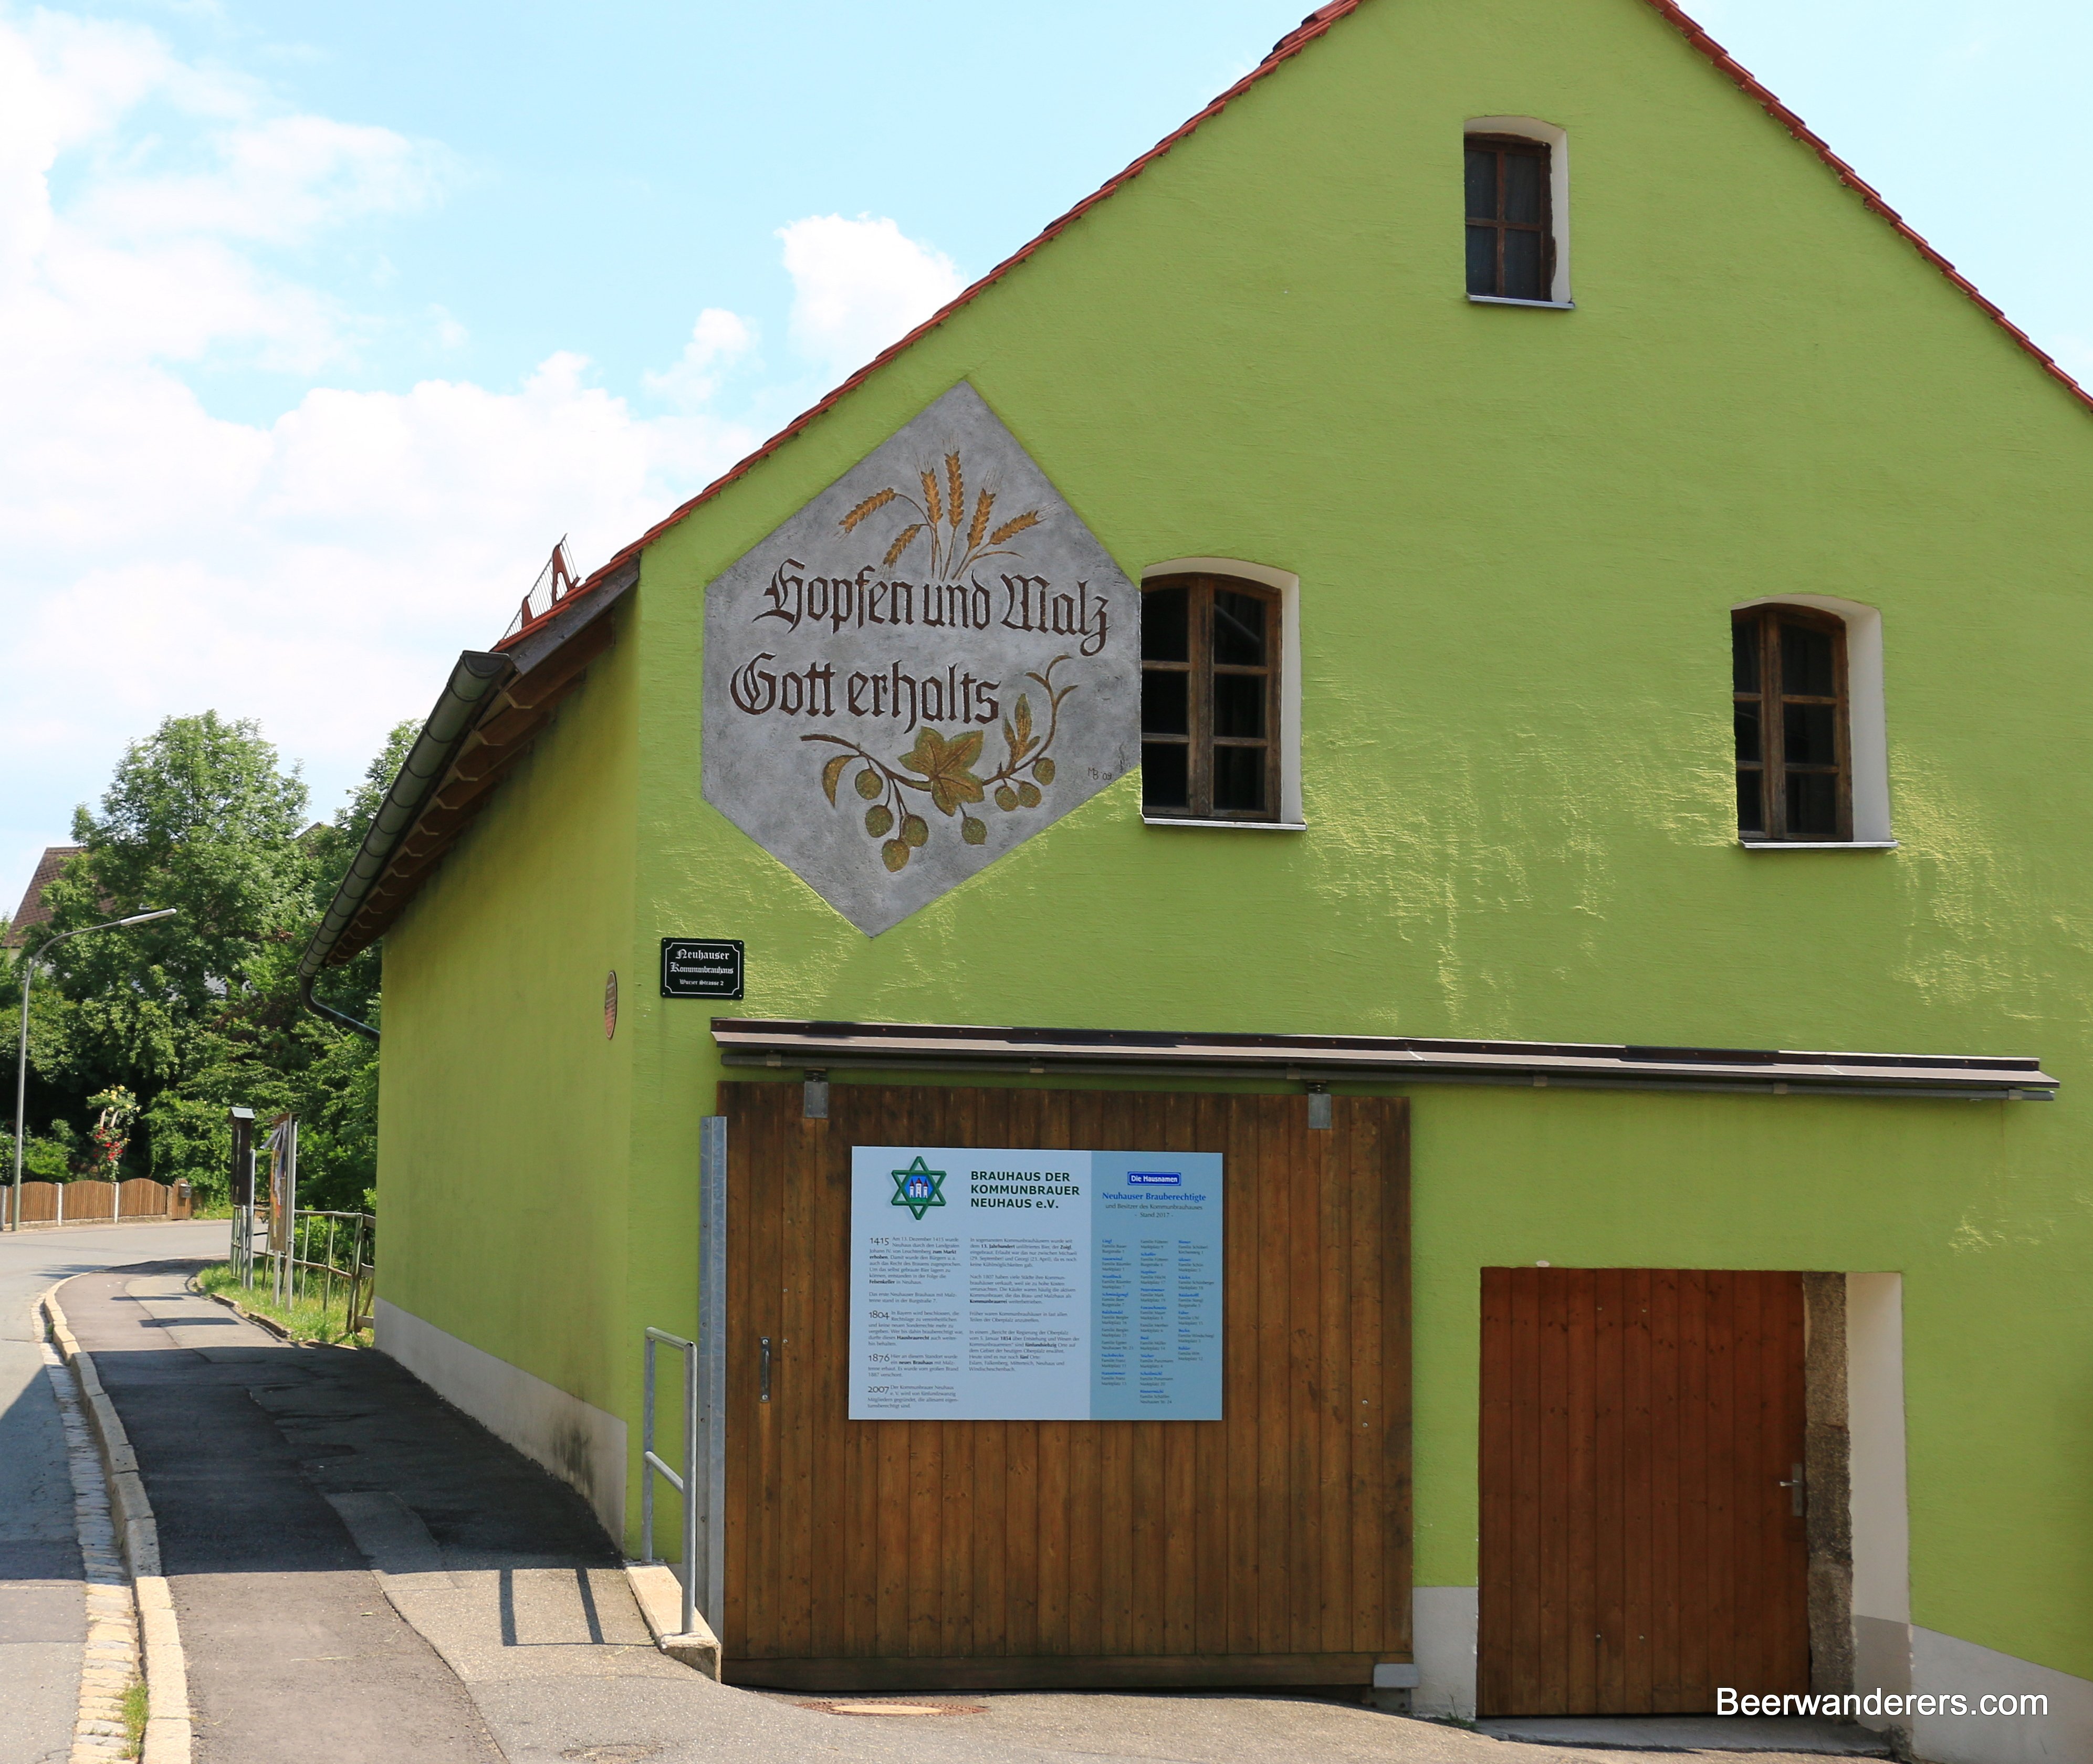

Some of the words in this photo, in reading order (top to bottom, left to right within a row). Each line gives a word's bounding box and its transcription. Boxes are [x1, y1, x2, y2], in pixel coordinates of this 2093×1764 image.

[752, 558, 915, 634] Hopfen
[922, 570, 991, 631] und
[1000, 573, 1113, 657] Malz
[730, 652, 837, 718] Gott
[847, 659, 1002, 734] erhalts
[675, 948, 730, 961] Neuhauser
[970, 1171, 1041, 1181] BRAUHAUS
[1045, 1172, 1070, 1182] DER
[970, 1184, 1080, 1195] KOMMUNBRAUER
[970, 1198, 1032, 1208] NEUHAUS
[1036, 1199, 1059, 1209] e.V.
[1146, 1193, 1207, 1203] Brauberechtigte
[870, 1237, 889, 1246] 1415
[868, 1310, 889, 1320] 1804
[868, 1353, 889, 1363] 1876
[868, 1386, 889, 1394] 2007
